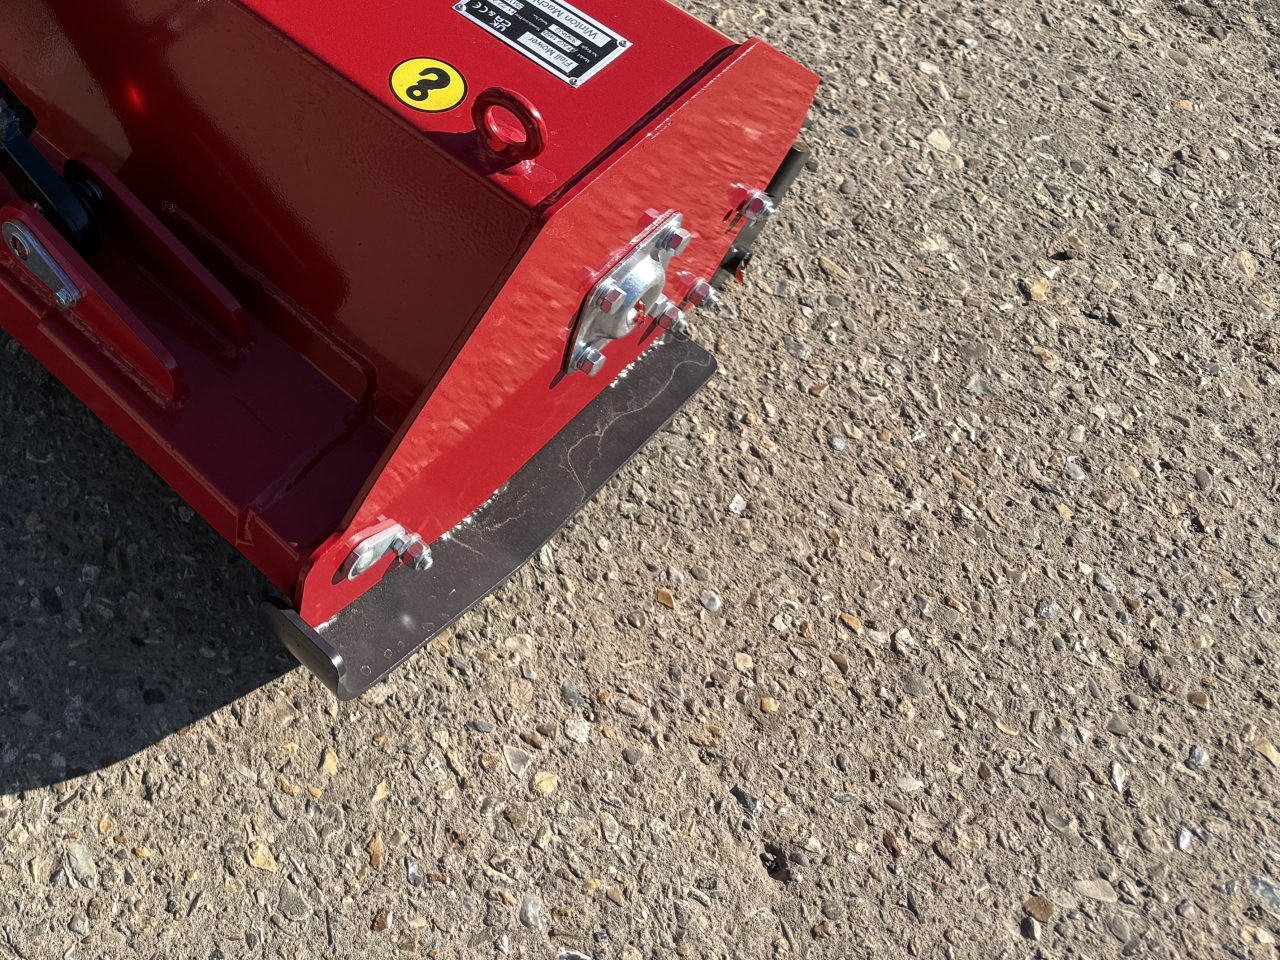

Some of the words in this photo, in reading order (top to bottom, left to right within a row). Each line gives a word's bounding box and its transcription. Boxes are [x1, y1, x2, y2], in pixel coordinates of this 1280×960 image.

[489, 19, 506, 31] UK
[563, 14, 598, 39] Winton
[527, 37, 555, 56] Mower
[553, 53, 573, 67] Flail
